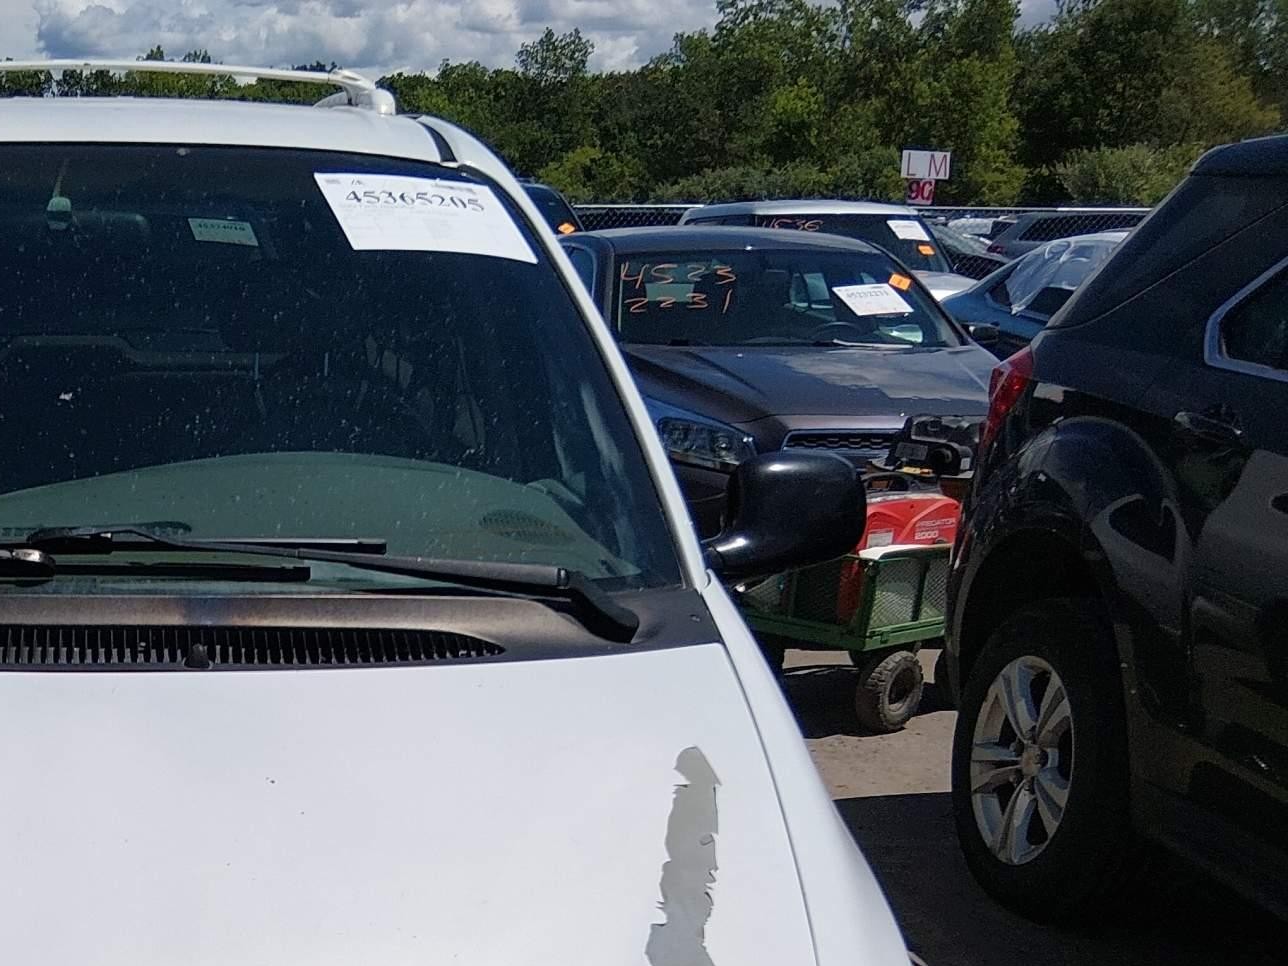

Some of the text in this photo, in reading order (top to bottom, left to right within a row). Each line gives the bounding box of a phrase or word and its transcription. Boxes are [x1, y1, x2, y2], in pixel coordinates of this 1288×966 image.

[907, 152, 948, 177] L M
[345, 189, 485, 213] 45365205
[907, 180, 933, 201] 90
[620, 261, 736, 289] 4523
[623, 288, 733, 314] 2231
